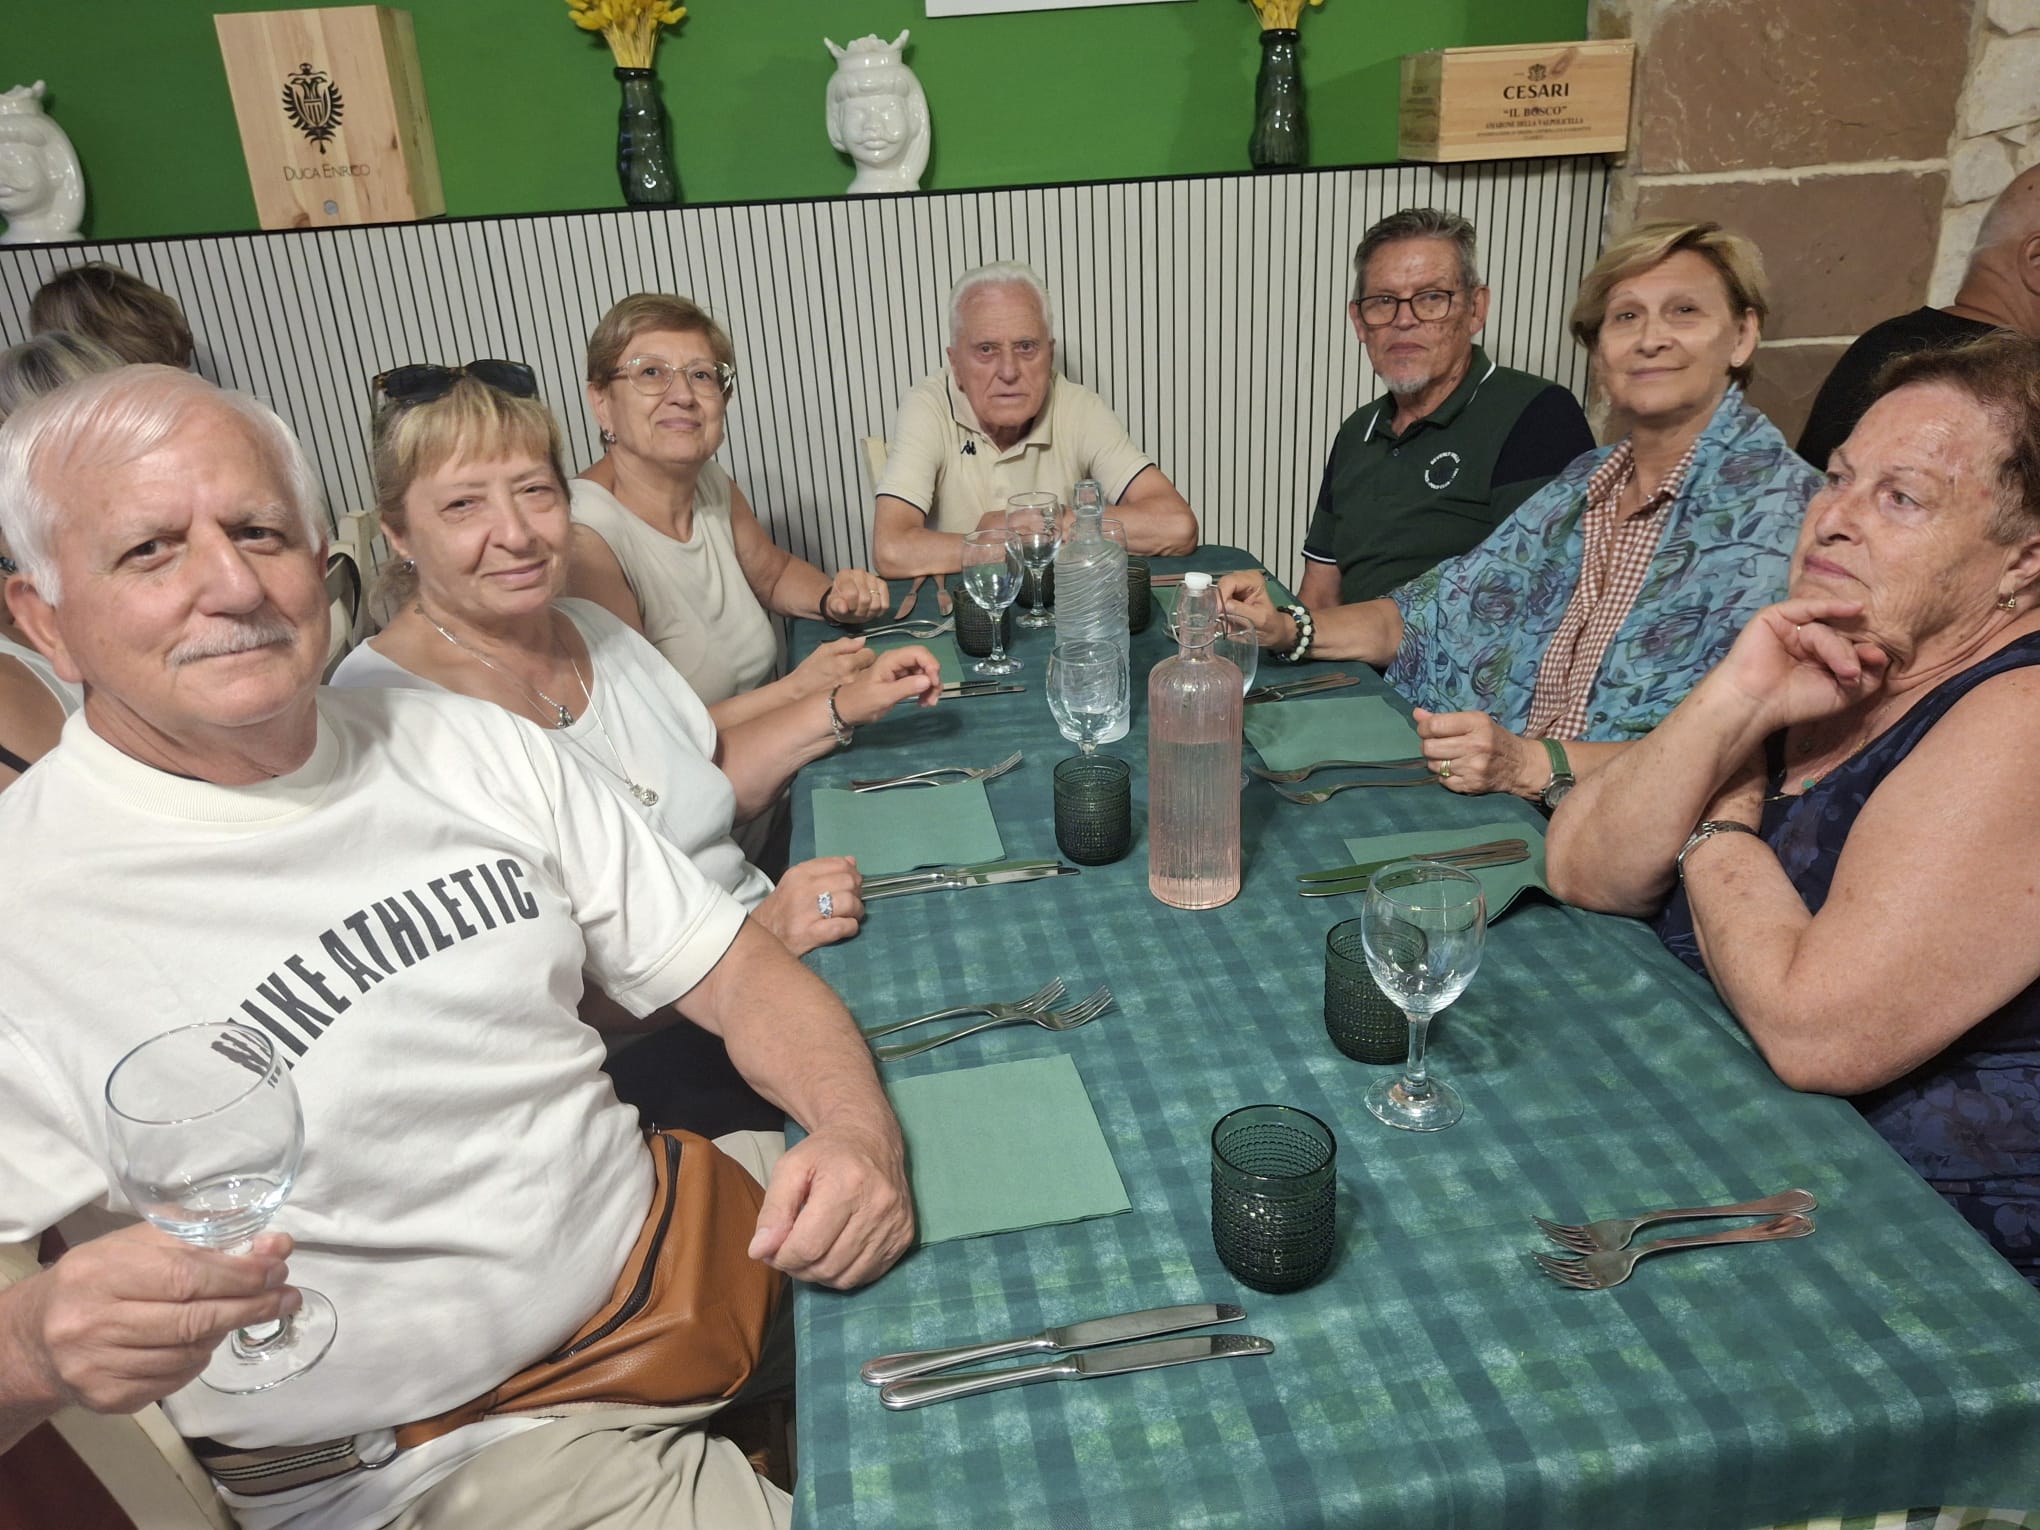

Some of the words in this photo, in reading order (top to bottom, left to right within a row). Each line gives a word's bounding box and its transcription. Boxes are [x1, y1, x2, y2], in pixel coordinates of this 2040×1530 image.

[1503, 83, 1569, 100] CESARI
[283, 166, 321, 181] DUCA
[318, 858, 540, 995] ATHLETIC
